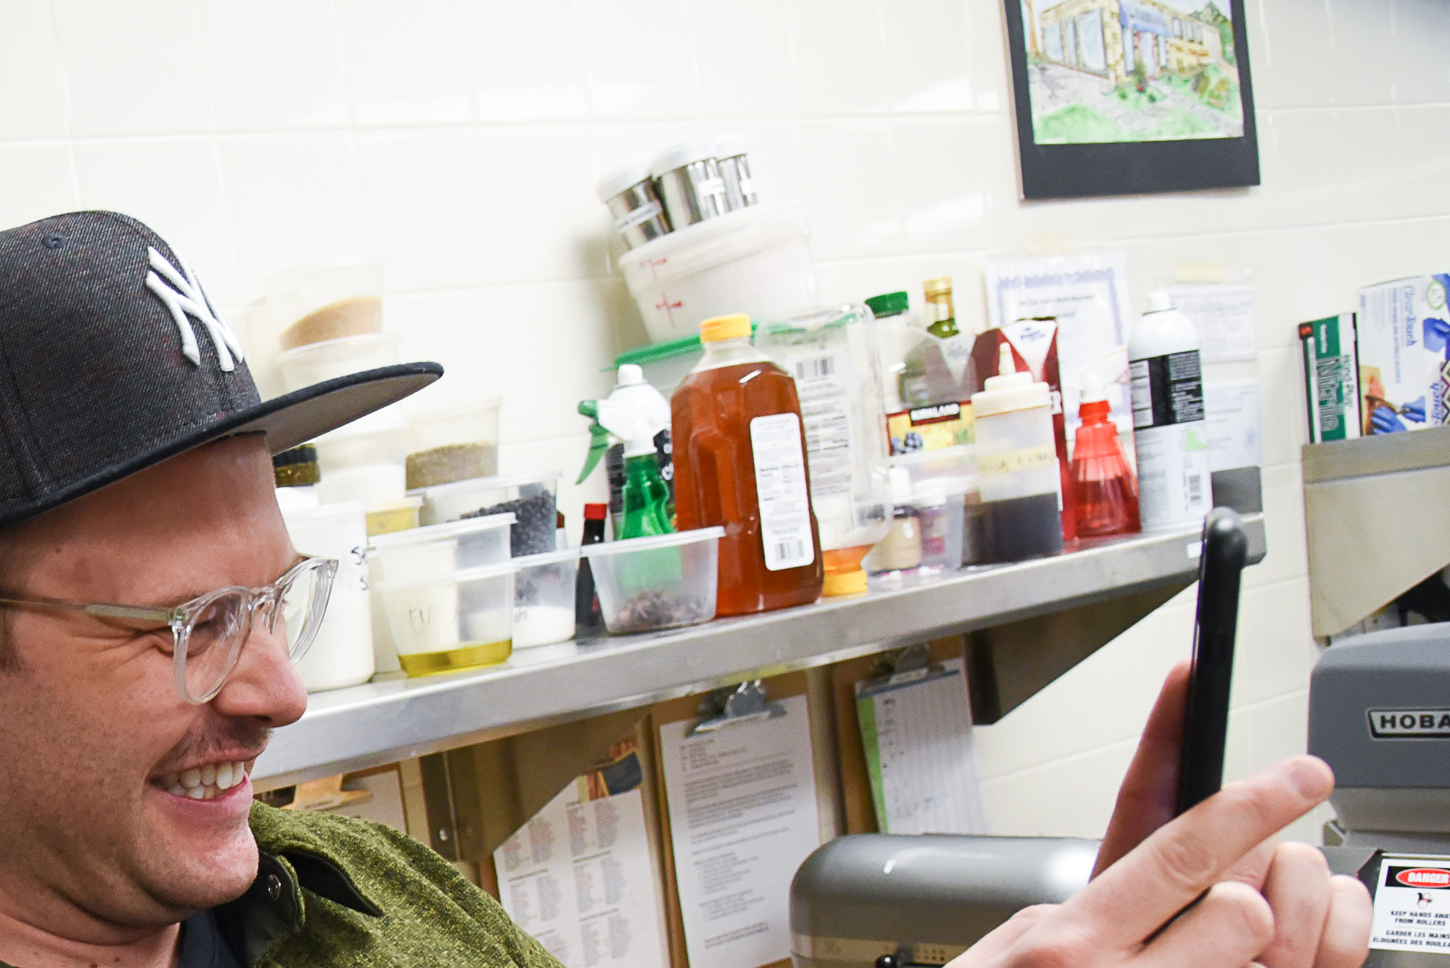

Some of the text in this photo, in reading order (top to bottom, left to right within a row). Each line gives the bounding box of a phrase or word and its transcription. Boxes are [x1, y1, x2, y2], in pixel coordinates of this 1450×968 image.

[1407, 872, 1449, 884] DANGER
[1416, 918, 1446, 926] ROLLERS
[1386, 929, 1412, 937] GARDER
